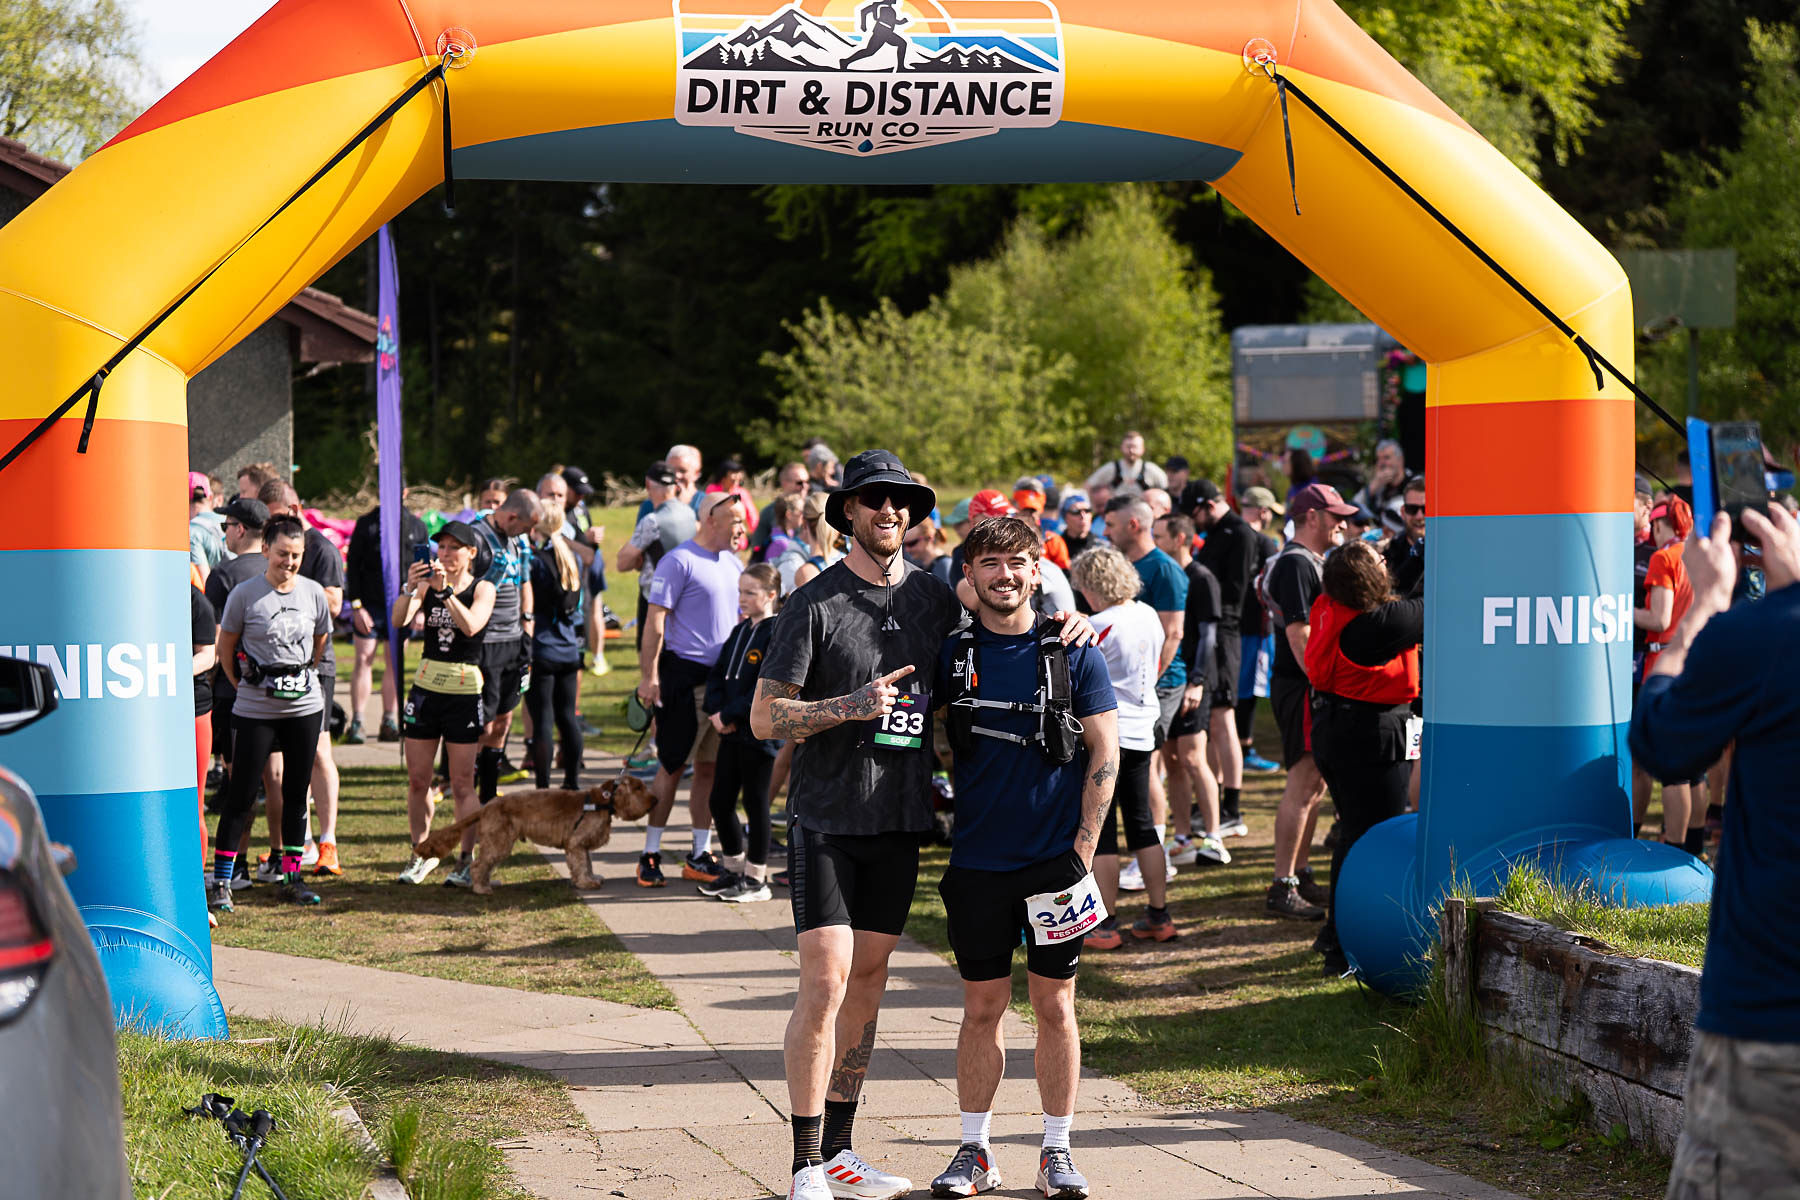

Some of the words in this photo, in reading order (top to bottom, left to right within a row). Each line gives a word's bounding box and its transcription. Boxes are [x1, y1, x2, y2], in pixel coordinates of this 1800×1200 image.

[686, 78, 786, 114] DIRT
[800, 79, 830, 116] &
[845, 81, 1053, 116] DISTANCE
[816, 122, 873, 137] RUN
[881, 122, 919, 137] CO
[1483, 593, 1632, 645] FINISH
[0, 643, 177, 699] NISH
[274, 669, 307, 692] 132
[878, 710, 924, 734] 133
[890, 737, 911, 745] SOLO
[1036, 893, 1096, 927] 344
[1053, 919, 1093, 938] FESTIVAL
